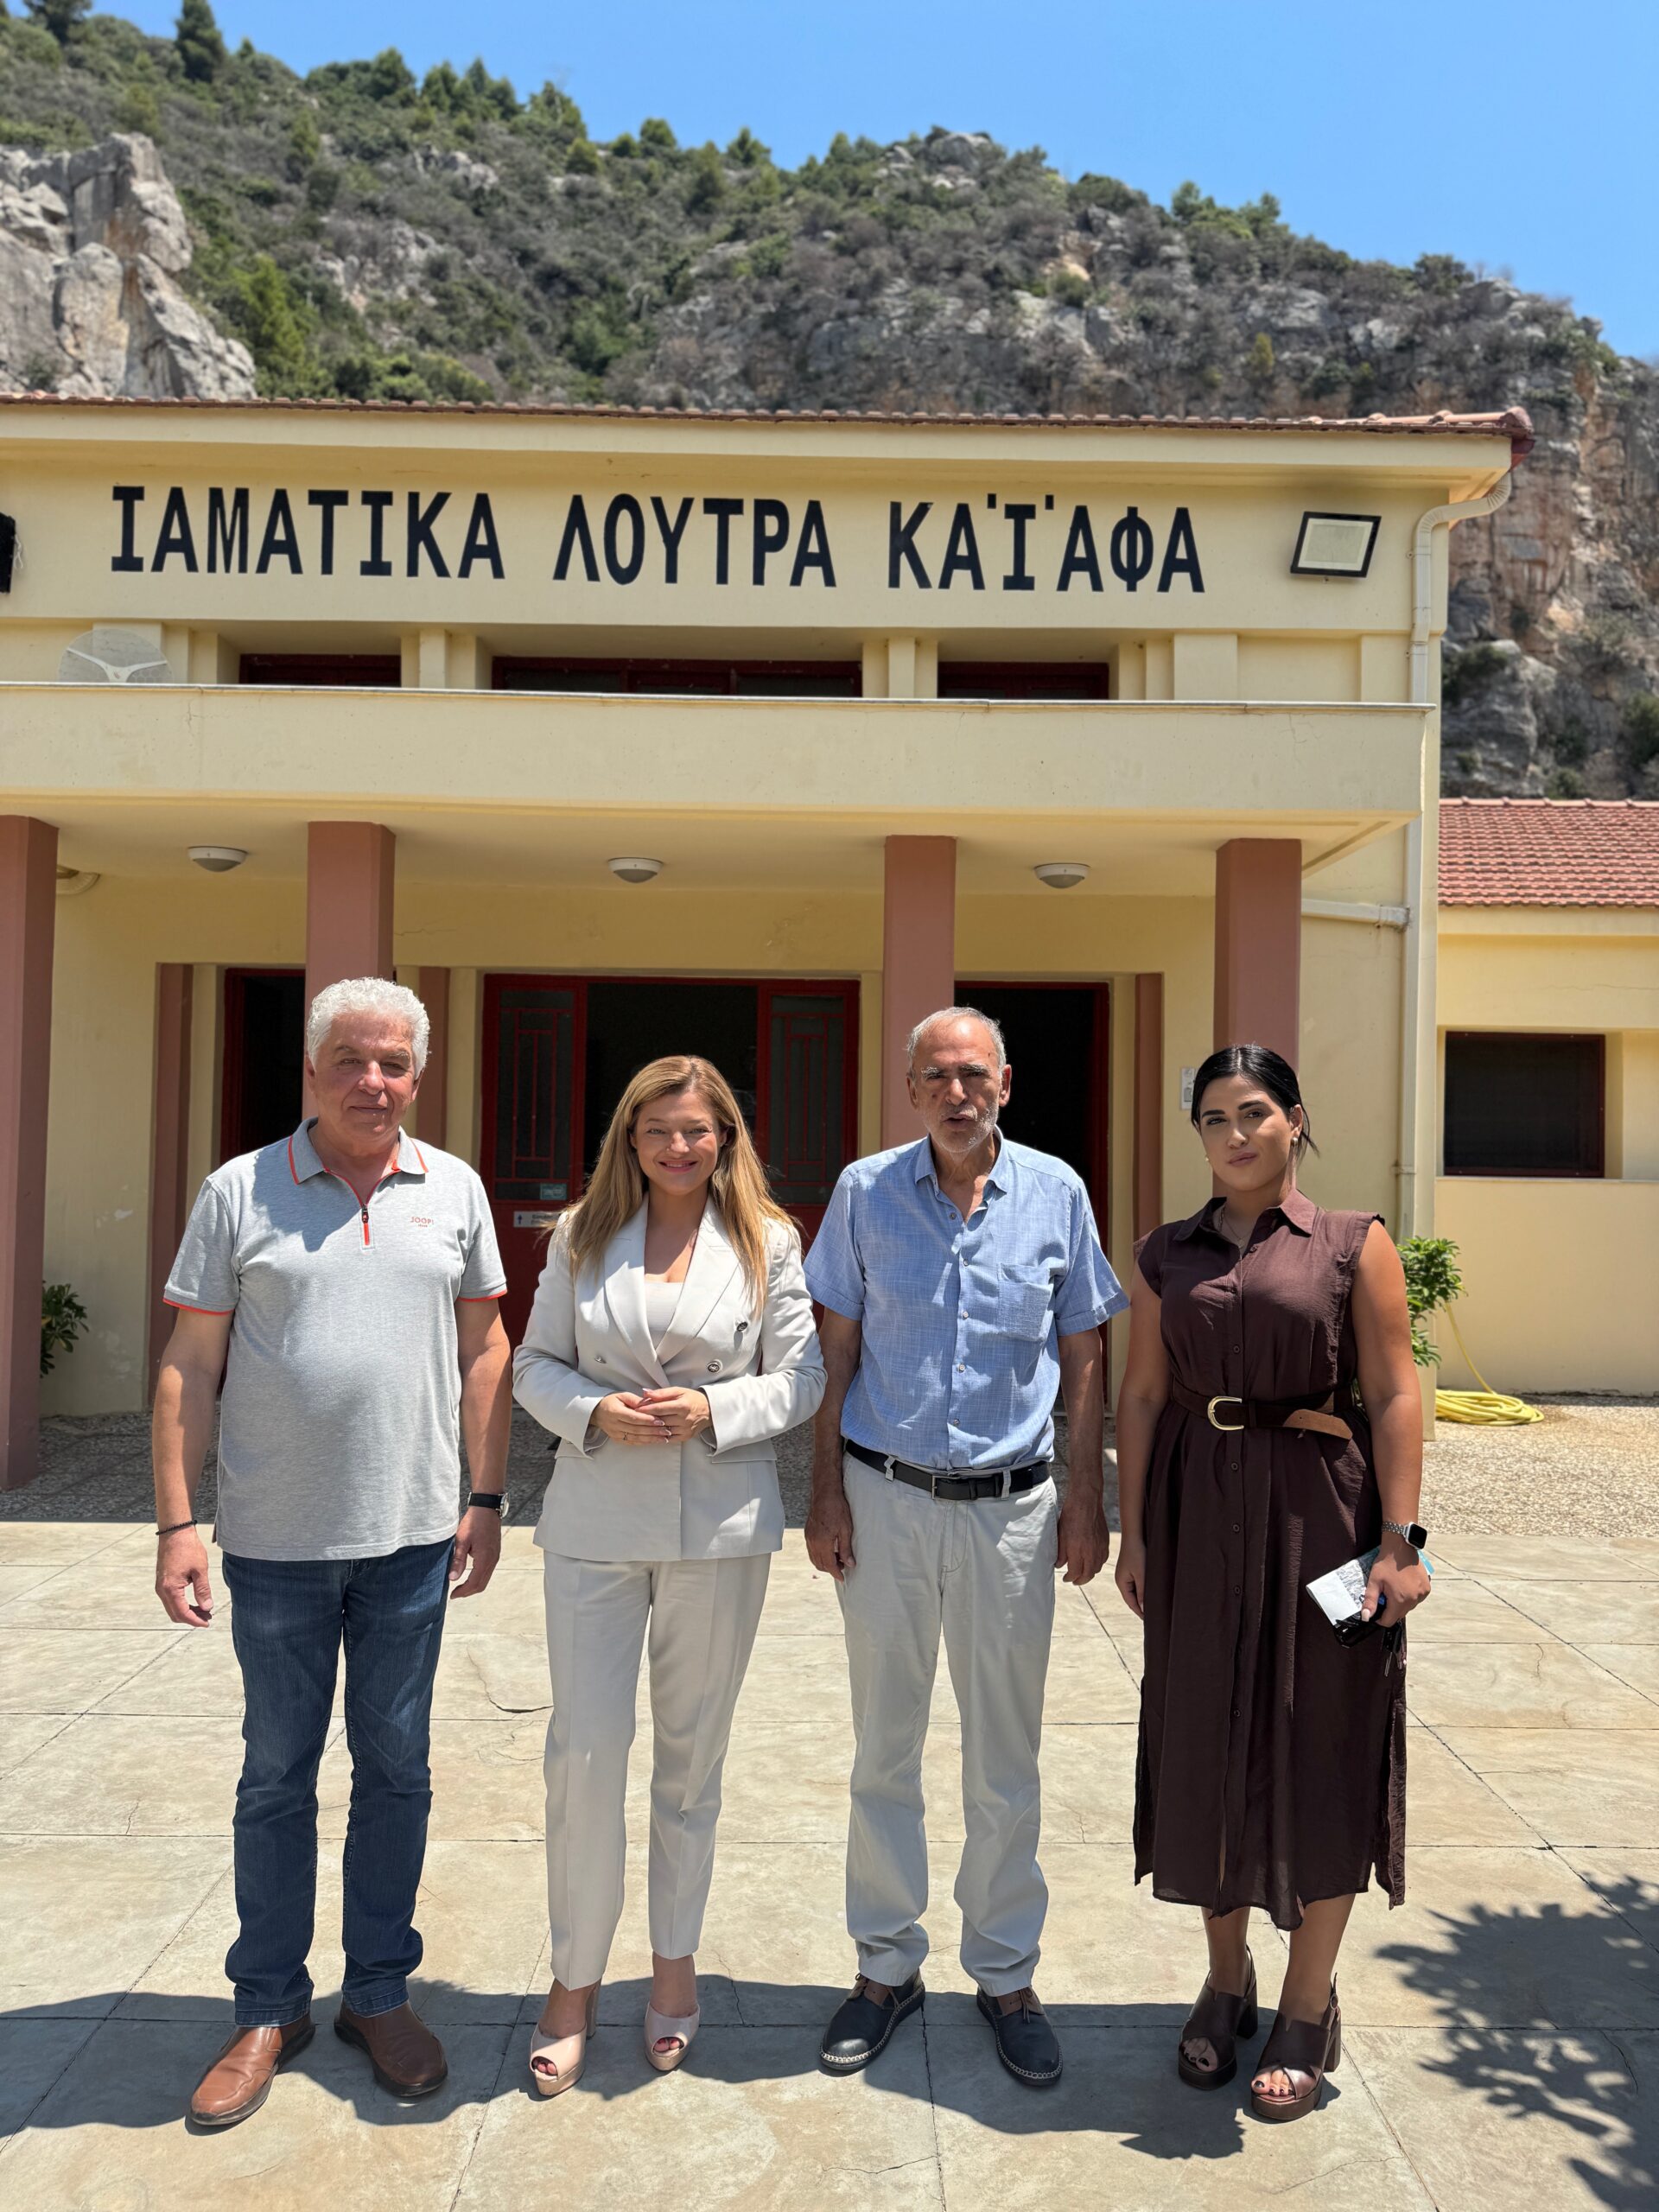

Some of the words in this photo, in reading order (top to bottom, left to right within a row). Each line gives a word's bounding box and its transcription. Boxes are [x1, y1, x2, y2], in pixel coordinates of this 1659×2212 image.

[111, 485, 505, 580] ΙΑΜΑΤΙΚΑ
[552, 493, 836, 588] ΛΟΥΤΡΑ
[888, 493, 1205, 593] ΚΑΪΑΦΑ
